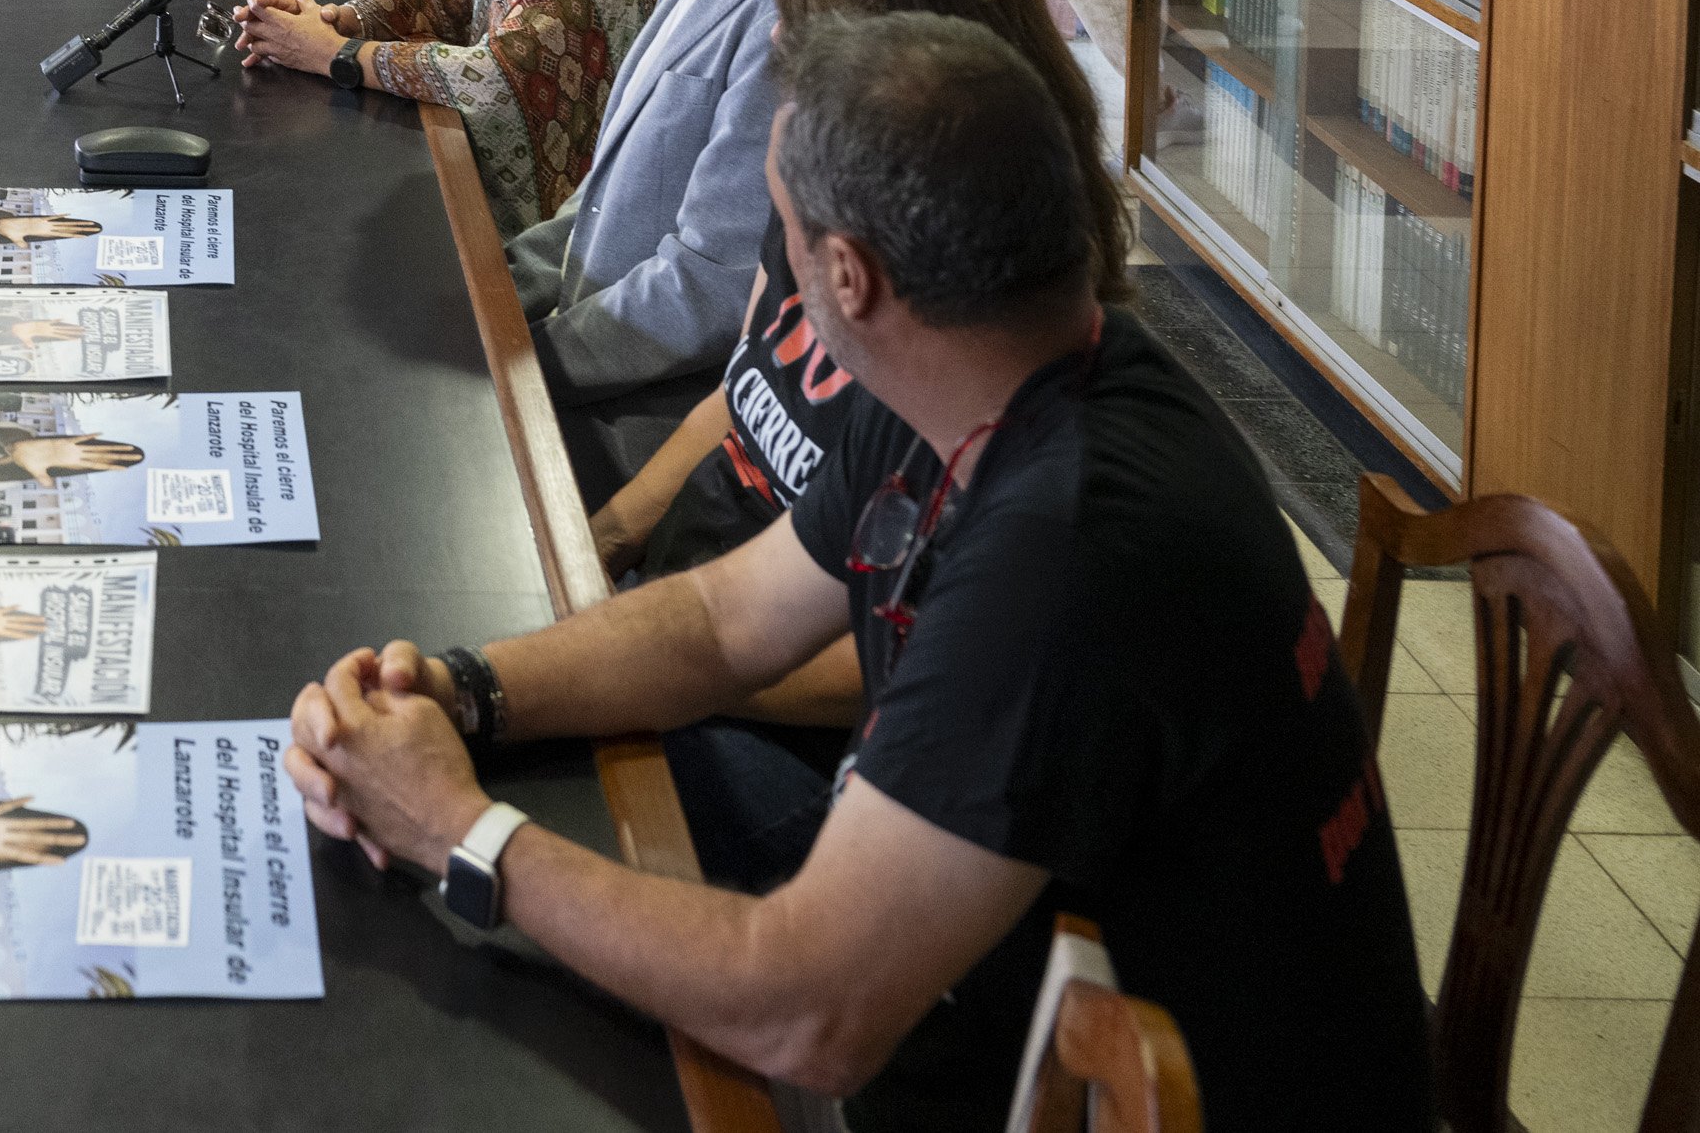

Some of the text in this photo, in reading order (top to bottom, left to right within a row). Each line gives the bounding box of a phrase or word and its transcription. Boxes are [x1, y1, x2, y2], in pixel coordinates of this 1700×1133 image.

[154, 194, 170, 232] Lanzarote
[178, 195, 196, 279] del Hospital Insular de
[207, 194, 222, 259] Paremos el cierre
[125, 300, 158, 376] MANIFESTACIÓN
[207, 401, 226, 458] Lanzarote
[237, 401, 267, 534] del Hospital Insular de
[271, 400, 296, 501] Paremos el cierre
[733, 367, 825, 497] CIERRE
[39, 591, 67, 695] HOSPITAL INSULAR
[69, 592, 90, 647] SALVAR EL
[91, 575, 138, 704] MANIFESTACIÓN
[174, 737, 198, 839] Lanzarote
[258, 735, 292, 928] Paremos el cierre
[213, 737, 252, 984] del Hospital Insular de
